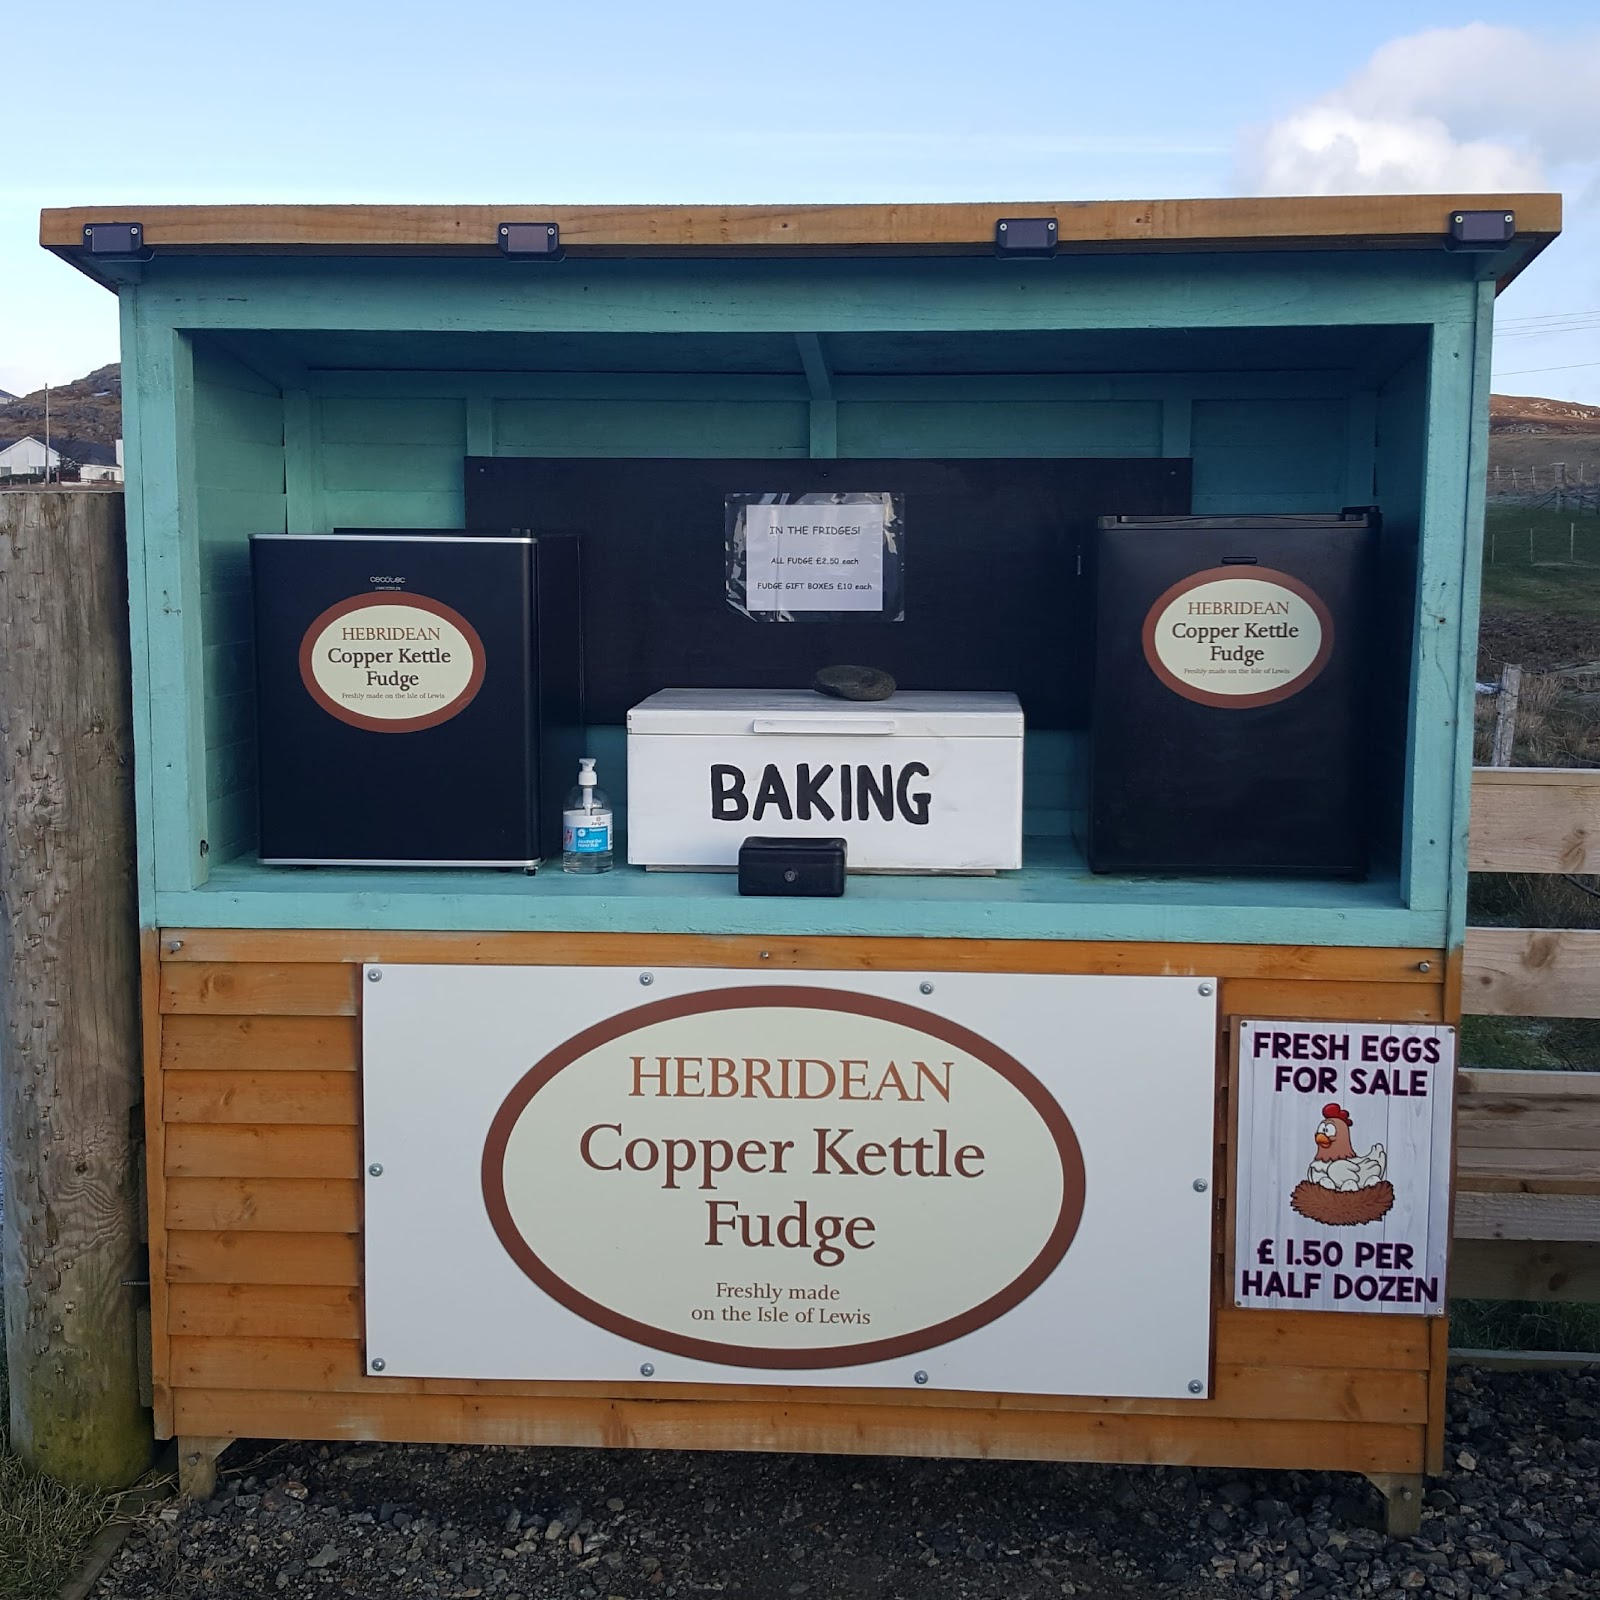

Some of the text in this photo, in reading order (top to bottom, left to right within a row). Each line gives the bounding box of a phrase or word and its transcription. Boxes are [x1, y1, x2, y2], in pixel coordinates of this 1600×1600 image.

[769, 526, 861, 535] IN THE FRIDGES!
[771, 557, 785, 565] ALL
[787, 557, 813, 565] FUDGE
[816, 557, 839, 565] £2.50
[757, 582, 783, 590] FUDGE
[785, 582, 804, 590] GIFT
[808, 582, 834, 590] BOXES
[837, 582, 853, 590] £10
[1187, 601, 1289, 615] HEBRIDEAN
[342, 627, 441, 641] HEBRIDEAN
[1172, 622, 1299, 643] Copper Kettle
[327, 648, 451, 668] Copper Kettle
[1210, 645, 1265, 666] Fudge
[366, 670, 419, 691] Fudge
[1184, 668, 1207, 676] Freshly
[342, 692, 364, 700] Freshly
[711, 762, 931, 825] BAKING
[1253, 1031, 1441, 1064] FRESH EGGS
[628, 1056, 954, 1103] HEBRIDEAN
[1275, 1066, 1428, 1097] FOR SALE
[580, 1122, 985, 1189] Copper Kettle
[704, 1200, 876, 1267] Fudge
[1286, 1239, 1343, 1267] 1.50
[1355, 1242, 1414, 1270] PER
[715, 1282, 840, 1305] Freshly made
[1241, 1270, 1438, 1303] HALF DOZEN
[691, 1306, 871, 1325] on the Isle of Lewis
